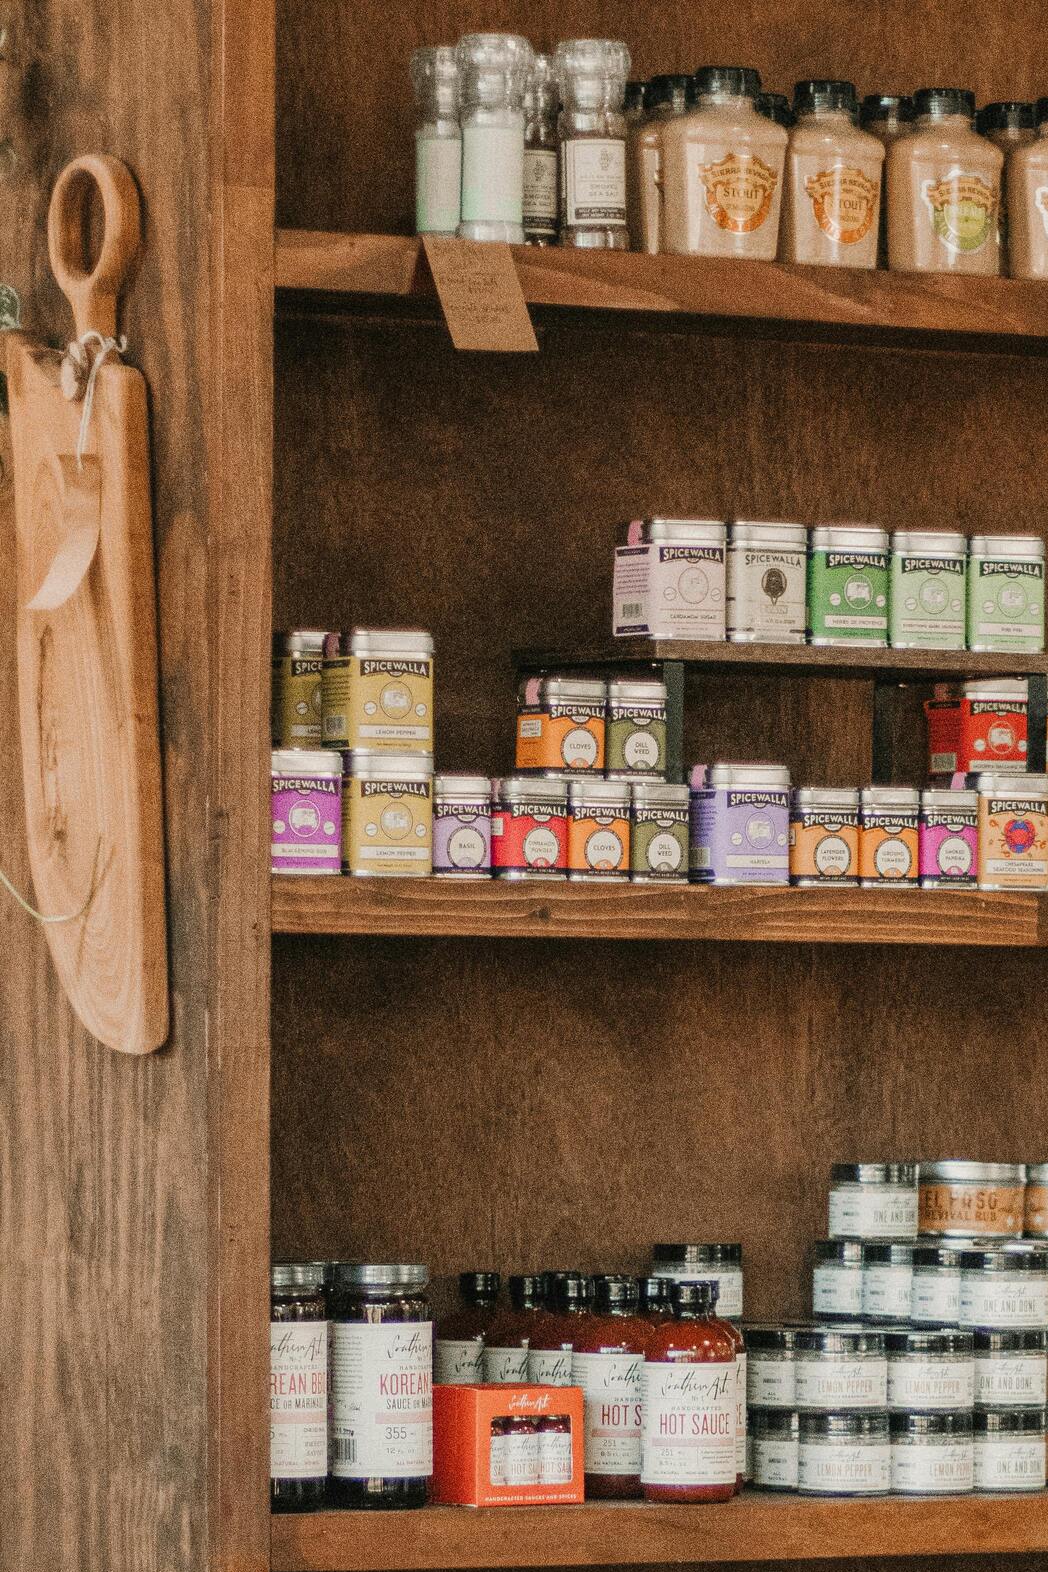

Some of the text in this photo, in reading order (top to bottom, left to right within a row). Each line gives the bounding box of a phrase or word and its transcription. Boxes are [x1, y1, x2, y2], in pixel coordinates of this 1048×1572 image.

[663, 548, 721, 561] SPICEWALLA
[745, 554, 801, 566] SPICEWALLA
[829, 554, 886, 568] SPICEWALLA
[904, 559, 961, 573] SPICEWALLA
[982, 563, 1040, 577] SPICEWALLA
[364, 661, 426, 676] SPICEWALLA
[272, 780, 335, 793] SPICEWALLA
[364, 782, 427, 796] SPICEWALLA
[730, 793, 787, 806] SPICEWALLA
[513, 804, 567, 818] SPICEWALLA
[990, 801, 1046, 814] SPICEWALLA
[804, 814, 858, 827] SPICEWALLA
[864, 816, 918, 829] SPICEWALLA
[925, 1191, 943, 1209] EL
[379, 1373, 429, 1396] KOREAN
[817, 1379, 873, 1393] LEMON PEPPER
[904, 1379, 960, 1393] LEMON PEPPER
[386, 1398, 412, 1409] SAUCE
[601, 1404, 630, 1426] HOT
[659, 1413, 730, 1435] HOT SAUCE
[384, 1426, 407, 1440] 355
[602, 1439, 617, 1447] 251
[816, 1463, 873, 1477] LEMON PEPPER
